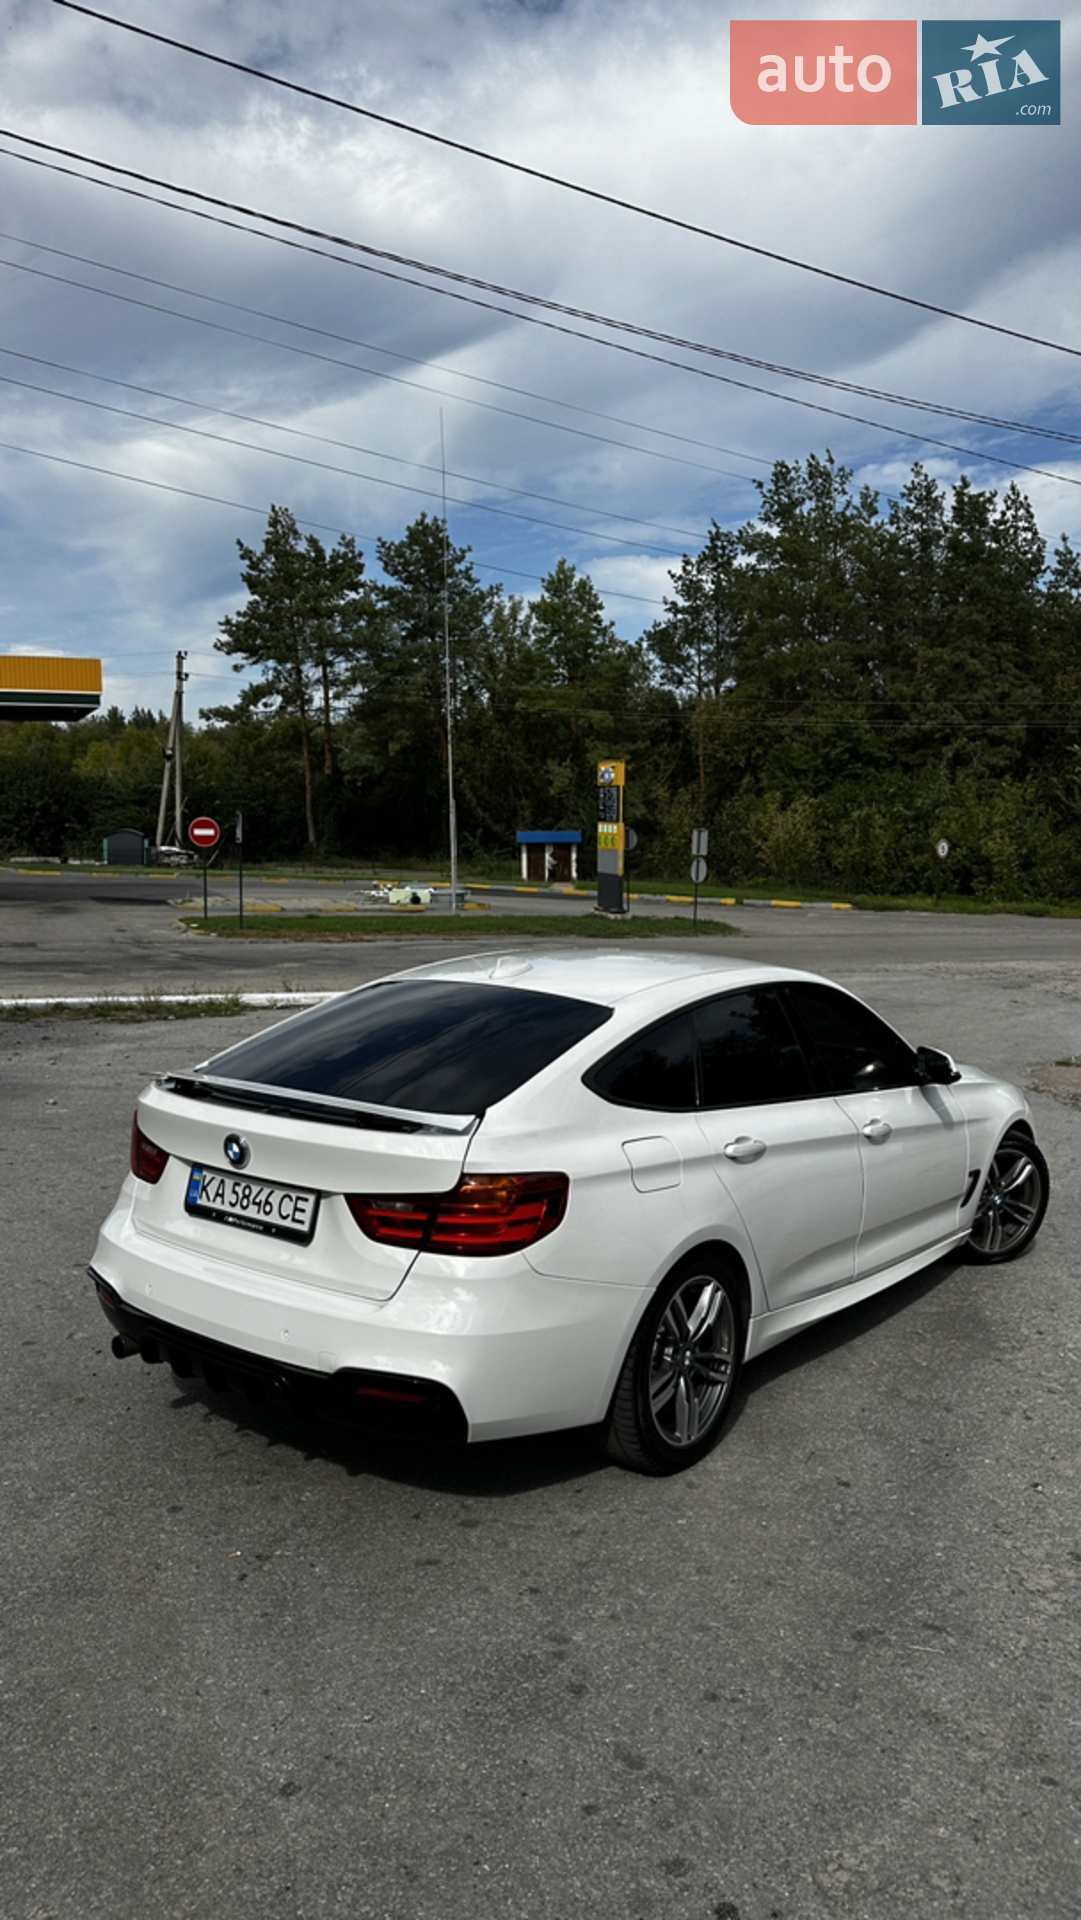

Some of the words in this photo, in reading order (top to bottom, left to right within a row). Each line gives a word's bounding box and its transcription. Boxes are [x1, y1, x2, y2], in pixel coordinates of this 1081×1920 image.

[199, 1174, 225, 1205] KA
[228, 1181, 275, 1216] 5846
[278, 1193, 309, 1225] CE
